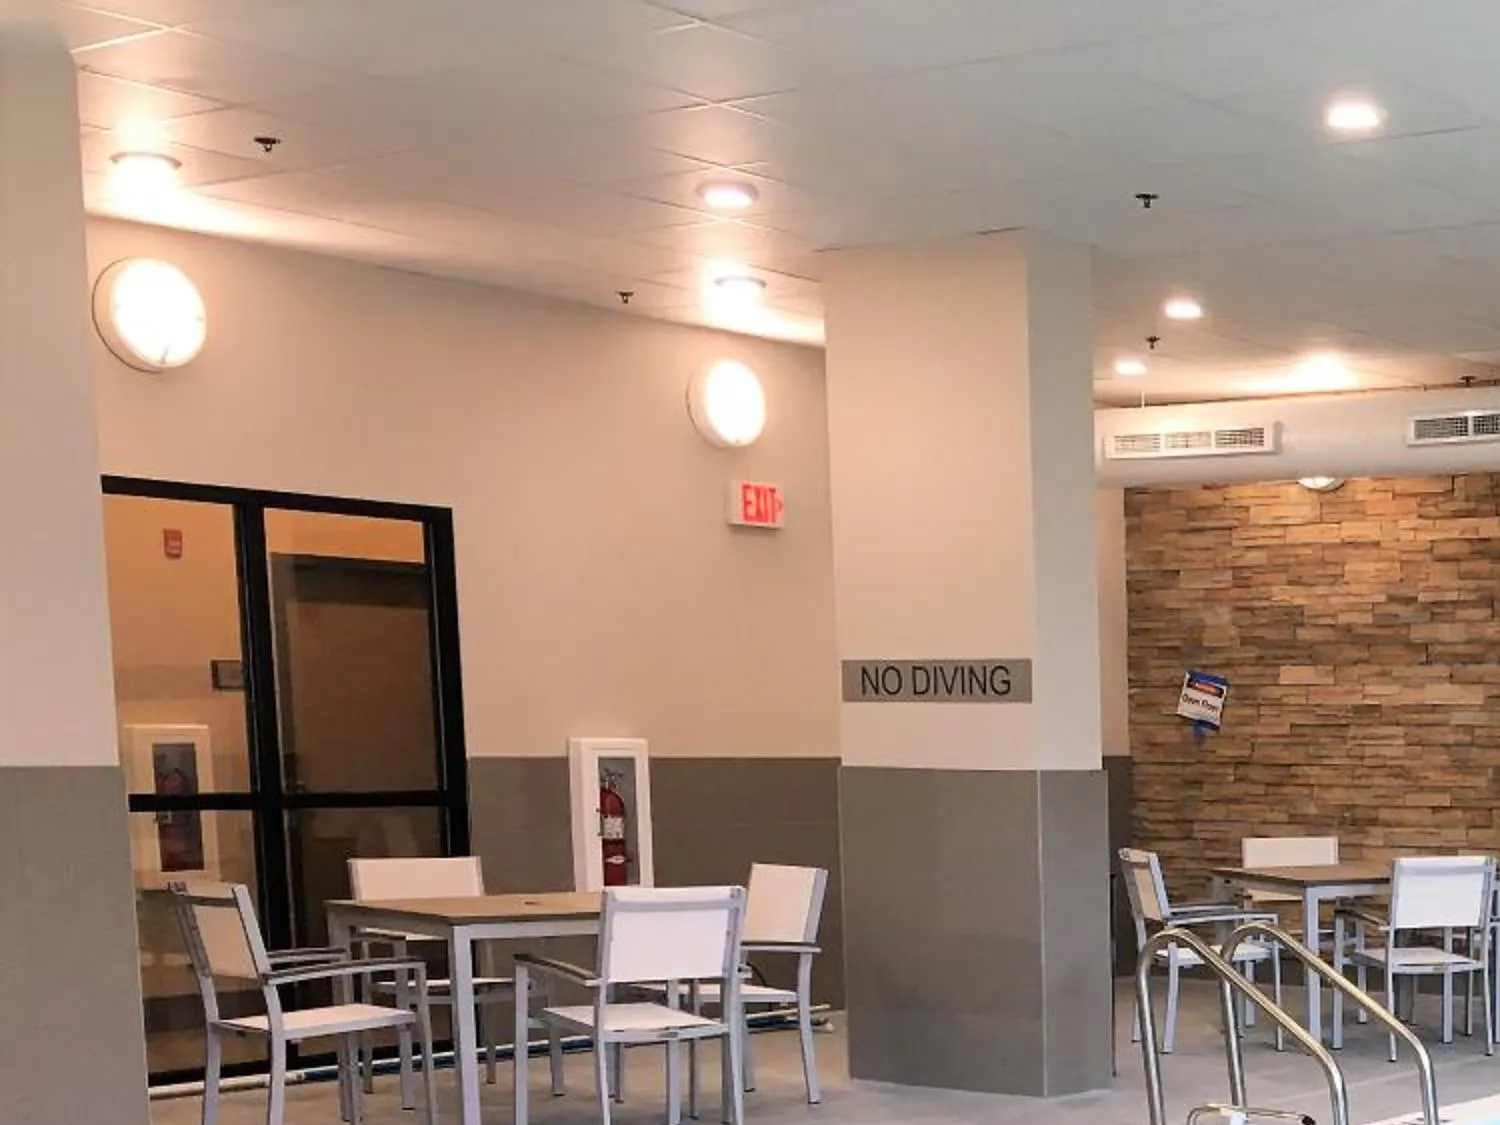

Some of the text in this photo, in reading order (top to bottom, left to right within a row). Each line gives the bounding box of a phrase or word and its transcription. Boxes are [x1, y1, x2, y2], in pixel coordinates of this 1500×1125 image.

[742, 484, 777, 523] EXIT
[861, 666, 1011, 696] NO DIVING
